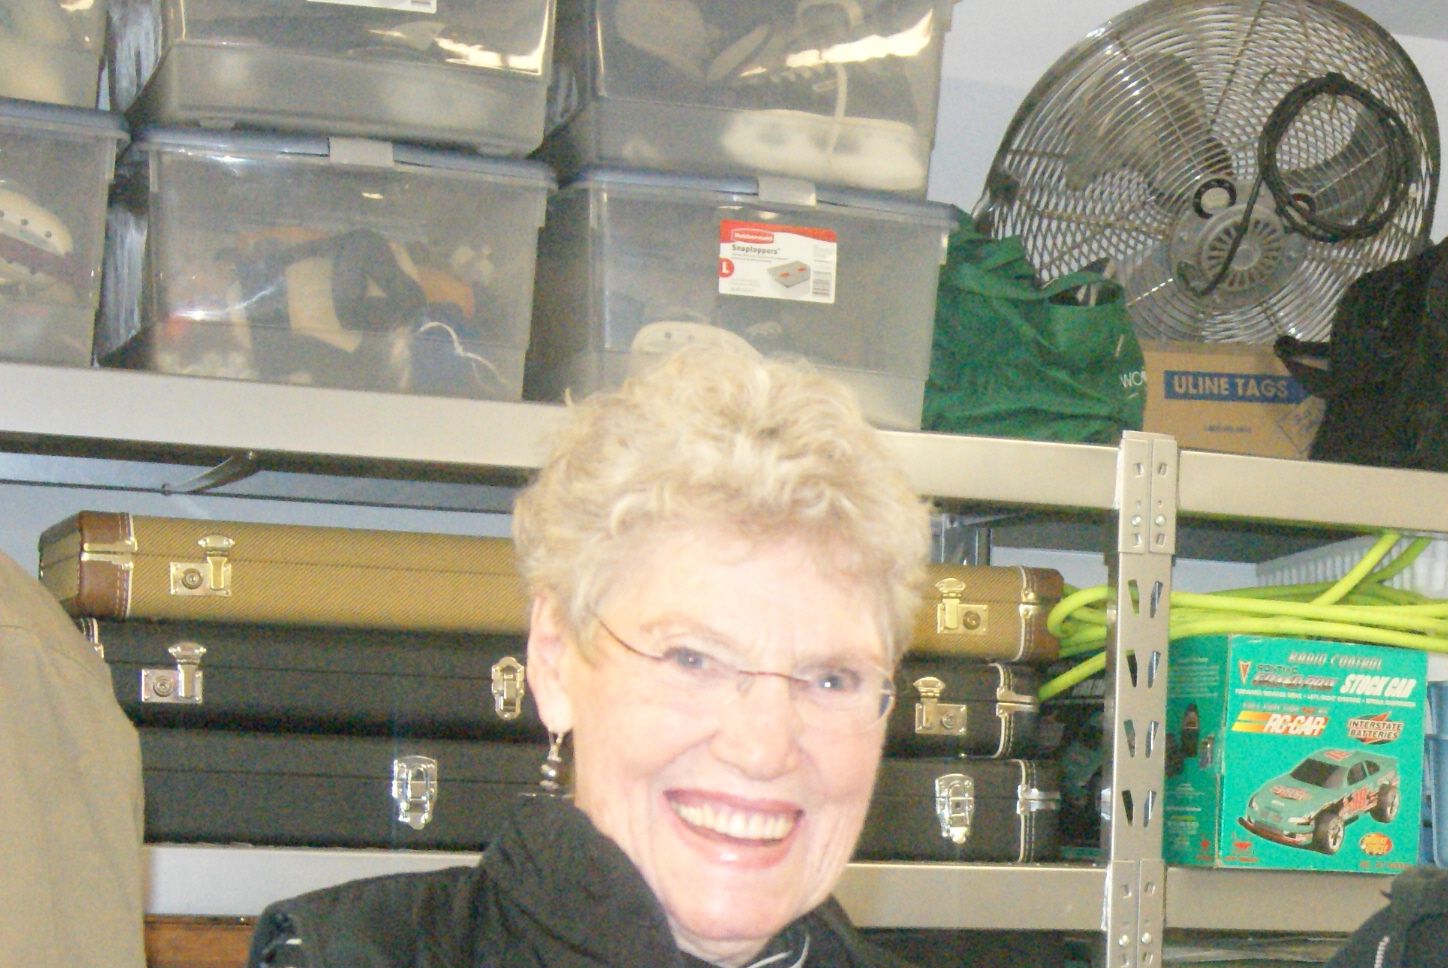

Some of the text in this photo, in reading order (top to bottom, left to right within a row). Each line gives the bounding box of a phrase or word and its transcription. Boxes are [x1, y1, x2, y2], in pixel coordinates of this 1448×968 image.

[1173, 374, 1288, 398] ULINE TAGS
[1339, 673, 1389, 697] STOCK
[1383, 677, 1417, 699] CAR
[1349, 720, 1402, 732] INTERSTATE
[1350, 729, 1400, 740] BATTERIES
